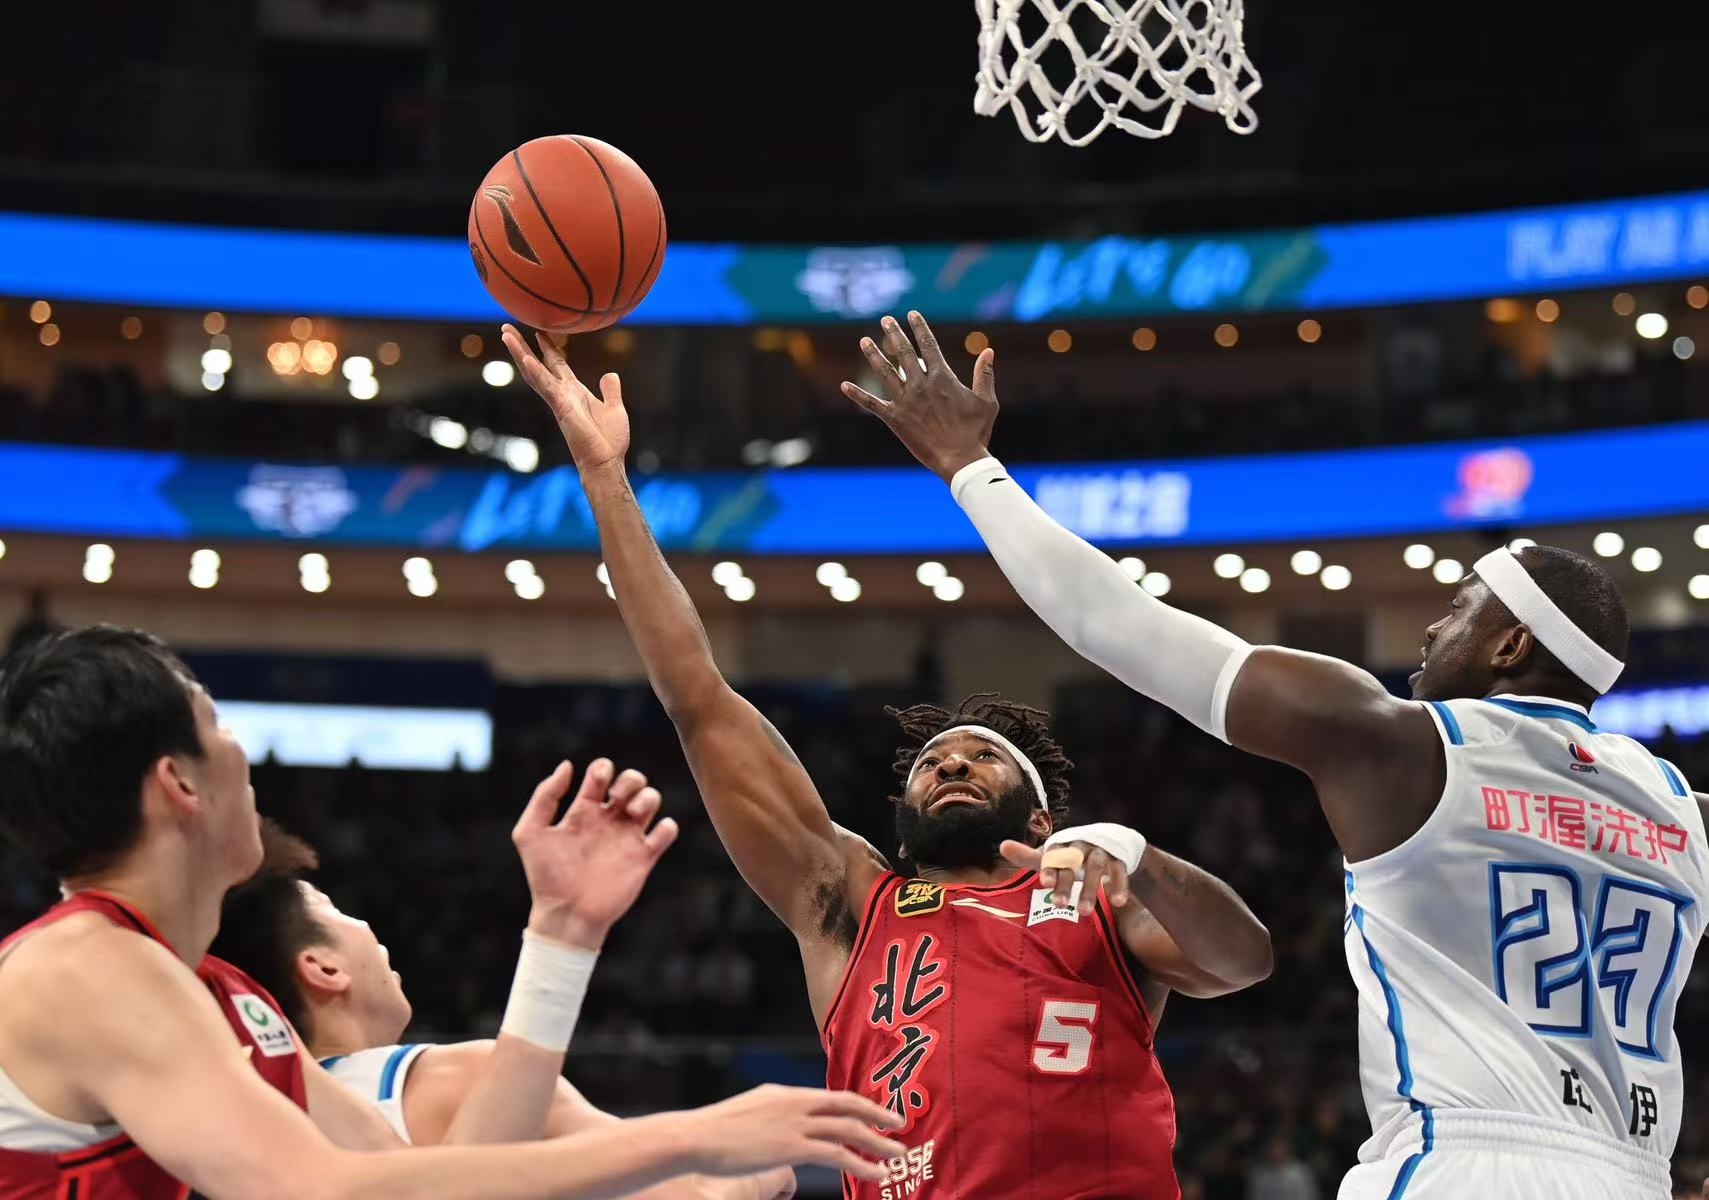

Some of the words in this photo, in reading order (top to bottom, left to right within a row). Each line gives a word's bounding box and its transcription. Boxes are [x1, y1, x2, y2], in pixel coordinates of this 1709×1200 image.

[1481, 786, 1689, 865] 町渥洗护
[1488, 861, 1695, 1061] 23
[870, 933, 946, 1132] 北京
[1032, 999, 1099, 1074] 5
